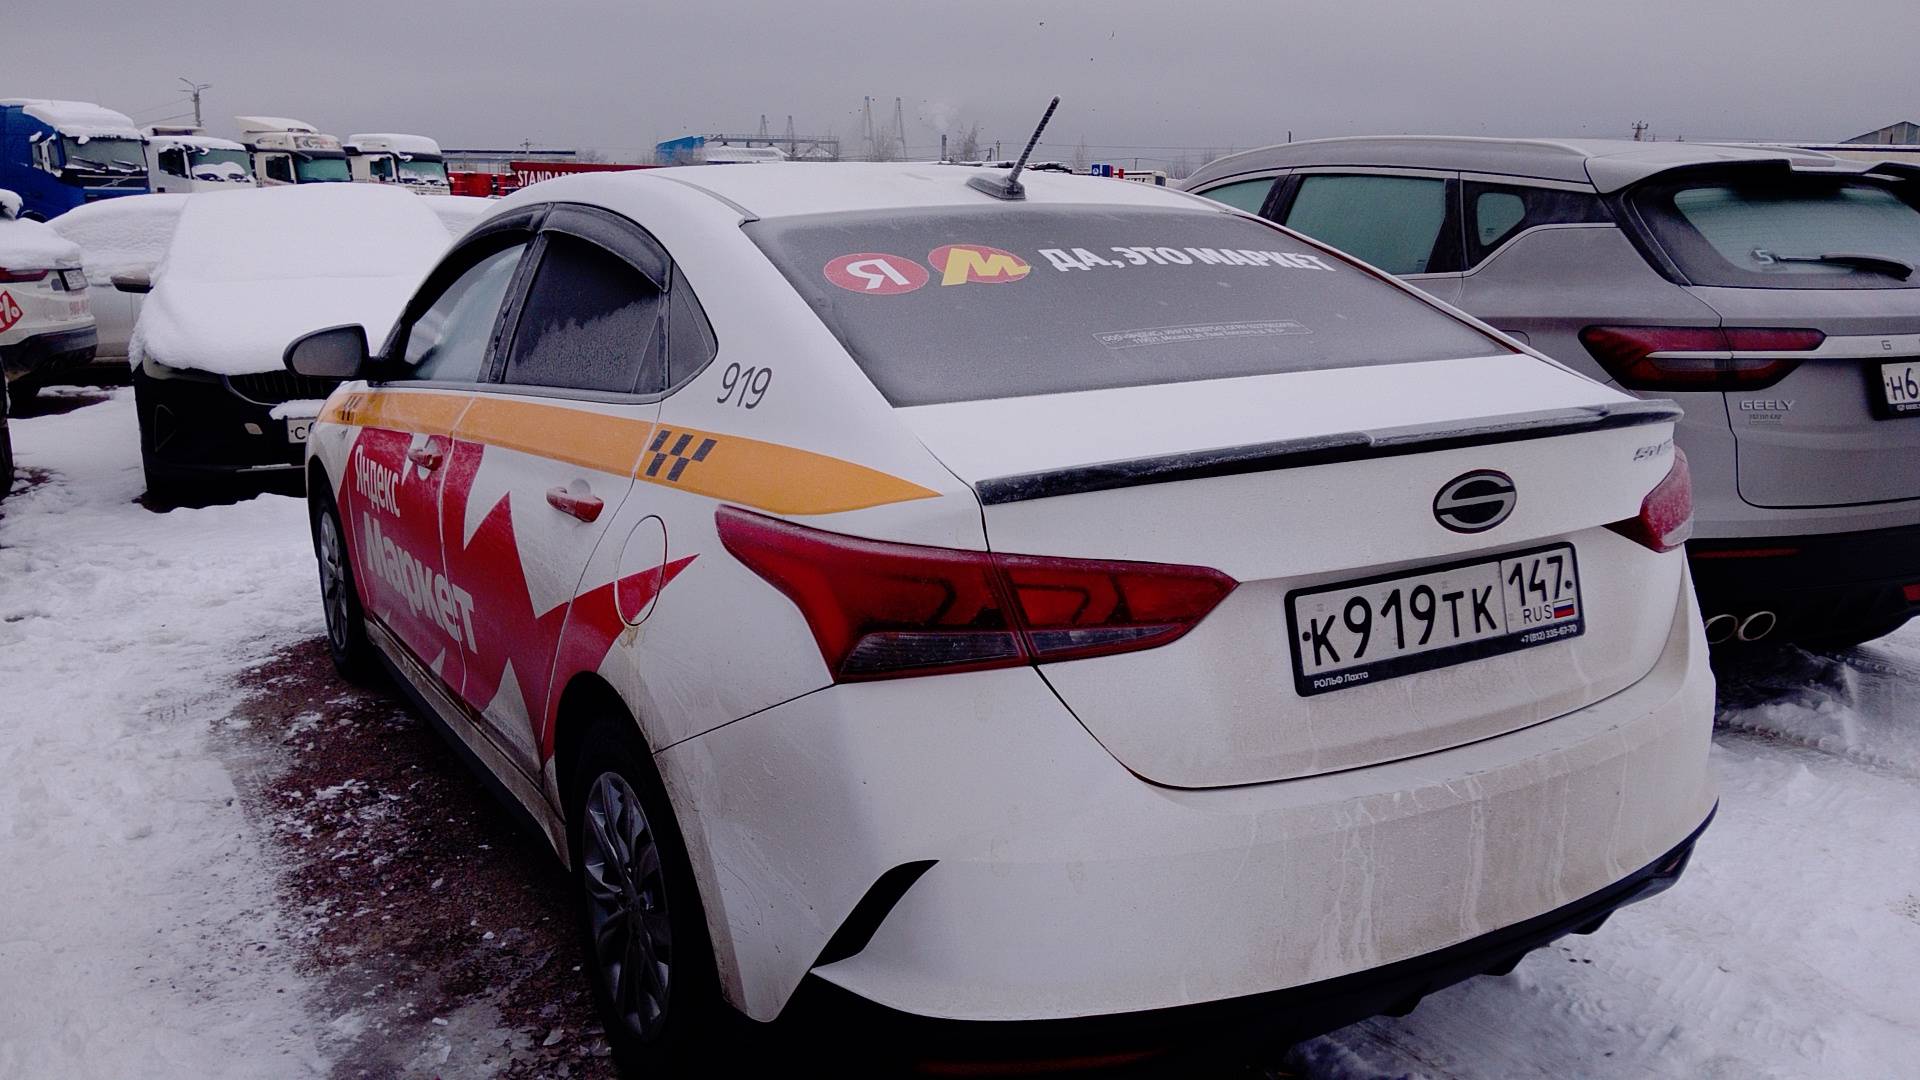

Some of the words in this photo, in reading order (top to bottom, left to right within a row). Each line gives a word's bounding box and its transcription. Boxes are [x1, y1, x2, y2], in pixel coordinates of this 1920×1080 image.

[846, 258, 911, 290] Я
[1110, 246, 1194, 265] ЭТО
[1183, 247, 1337, 272] МАРКЕТ
[717, 362, 772, 409] 919
[1740, 399, 1794, 411] GEELY
[354, 445, 401, 518] Яндекс
[363, 511, 478, 655] Маркет
[1310, 584, 1497, 667] К919ТК
[1508, 555, 1564, 607] 147
[1523, 604, 1553, 624] RUS
[1313, 675, 1343, 688] РОЛЬФ
[1344, 671, 1369, 682] Лахта
